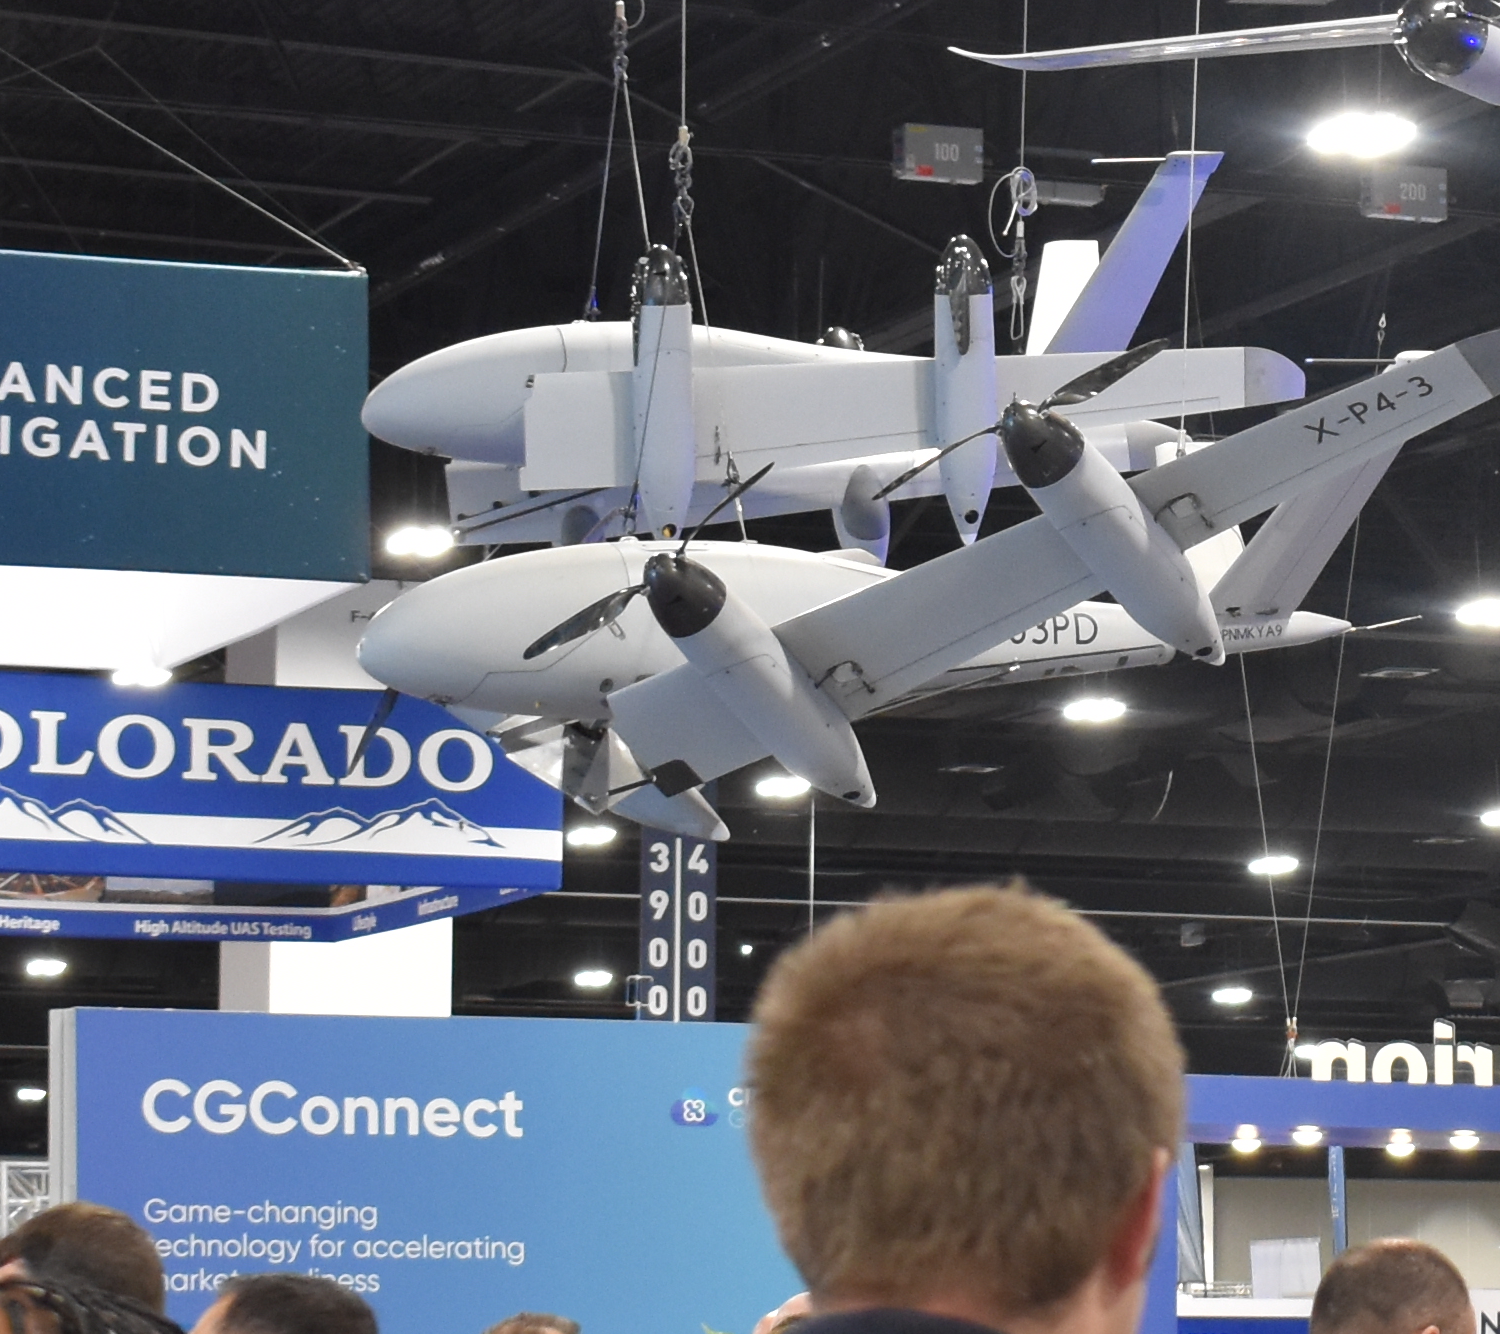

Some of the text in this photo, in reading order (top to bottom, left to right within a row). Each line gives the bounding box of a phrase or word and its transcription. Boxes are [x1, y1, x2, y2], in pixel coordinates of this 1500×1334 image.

[933, 142, 960, 163] 100
[1399, 181, 1428, 202] 200
[1303, 375, 1434, 445] X-P4-3
[134, 918, 313, 940] High Altitude UAS Testing
[647, 841, 670, 1016] 3900
[686, 843, 710, 1017] 4000
[141, 1077, 524, 1138] CGConnect
[142, 1197, 379, 1231] Game-changing
[308, 1234, 346, 1259] for
[352, 1235, 526, 1266] accelerating
